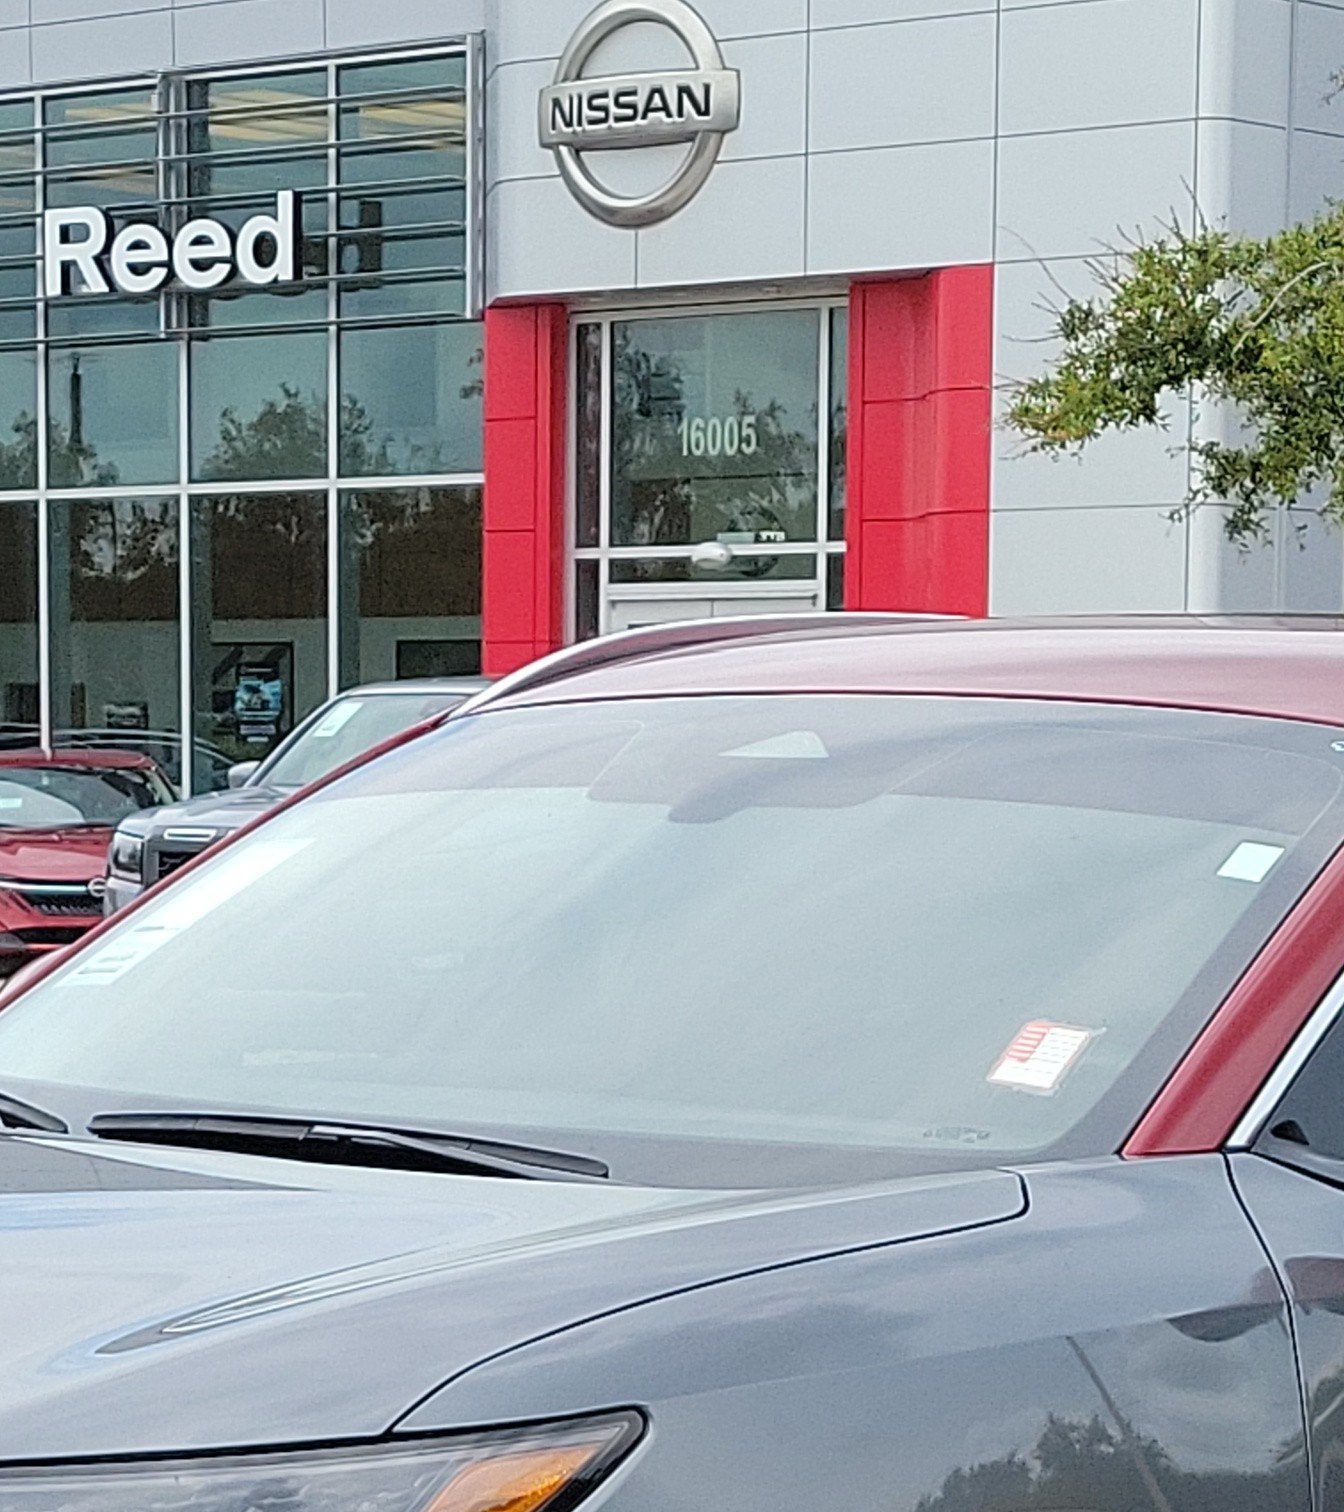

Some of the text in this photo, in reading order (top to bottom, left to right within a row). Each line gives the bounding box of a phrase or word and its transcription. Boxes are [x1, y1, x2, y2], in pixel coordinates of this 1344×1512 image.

[550, 82, 712, 132] NISSAN
[43, 189, 296, 297] Reed
[677, 414, 758, 457] 16005
